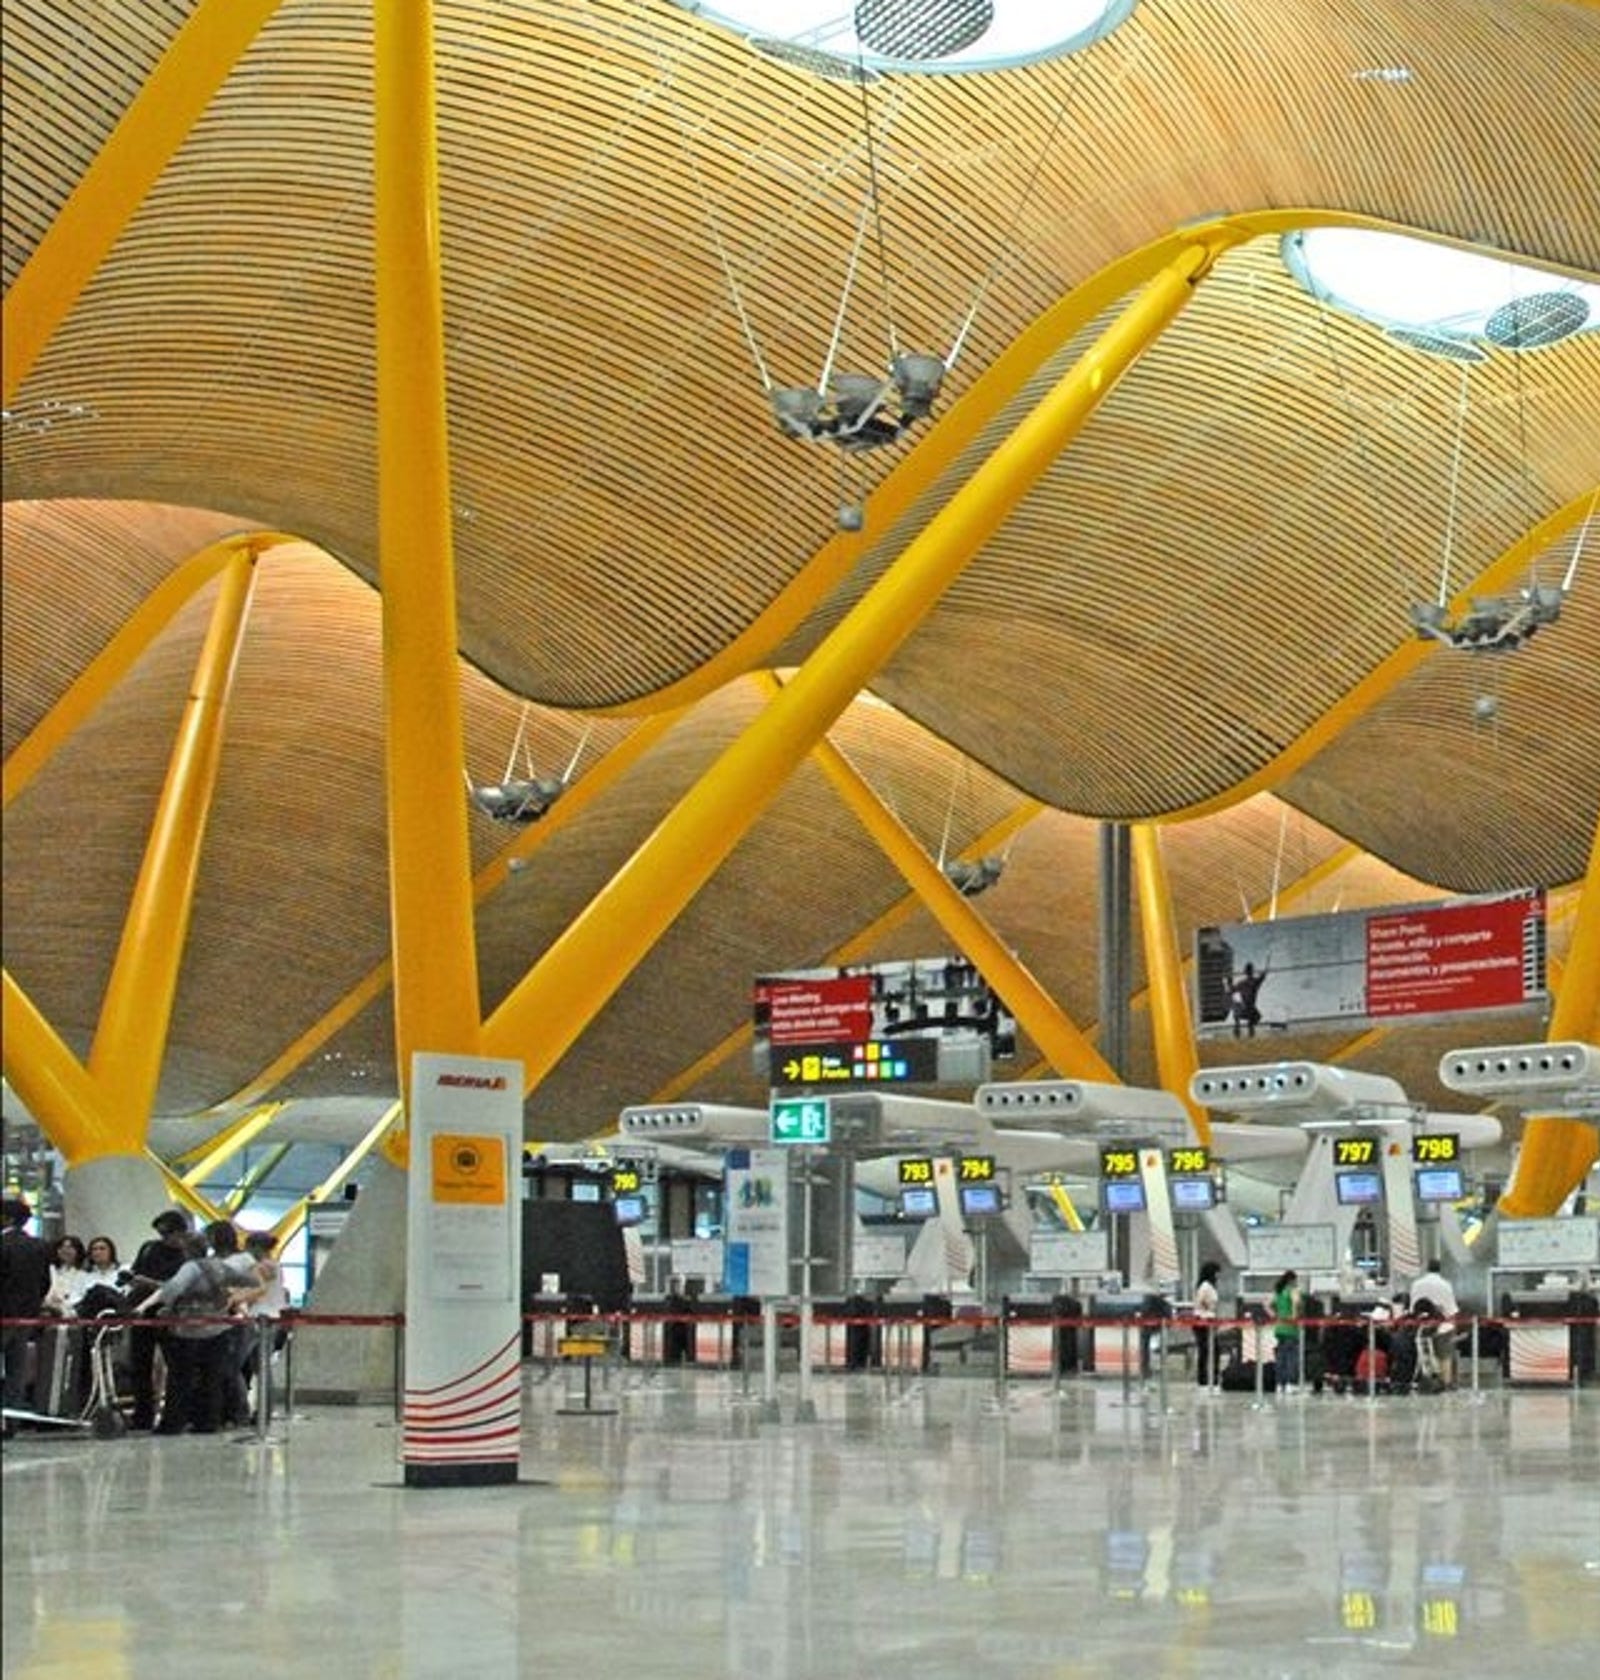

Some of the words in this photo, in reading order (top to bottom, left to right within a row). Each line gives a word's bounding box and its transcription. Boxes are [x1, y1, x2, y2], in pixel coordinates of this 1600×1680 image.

[1338, 1141, 1373, 1163] 797
[1417, 1137, 1454, 1159] 798
[961, 1159, 991, 1178] 794
[1105, 1153, 1136, 1174] 795
[1174, 1151, 1205, 1171] 796
[902, 1162, 930, 1181] 793
